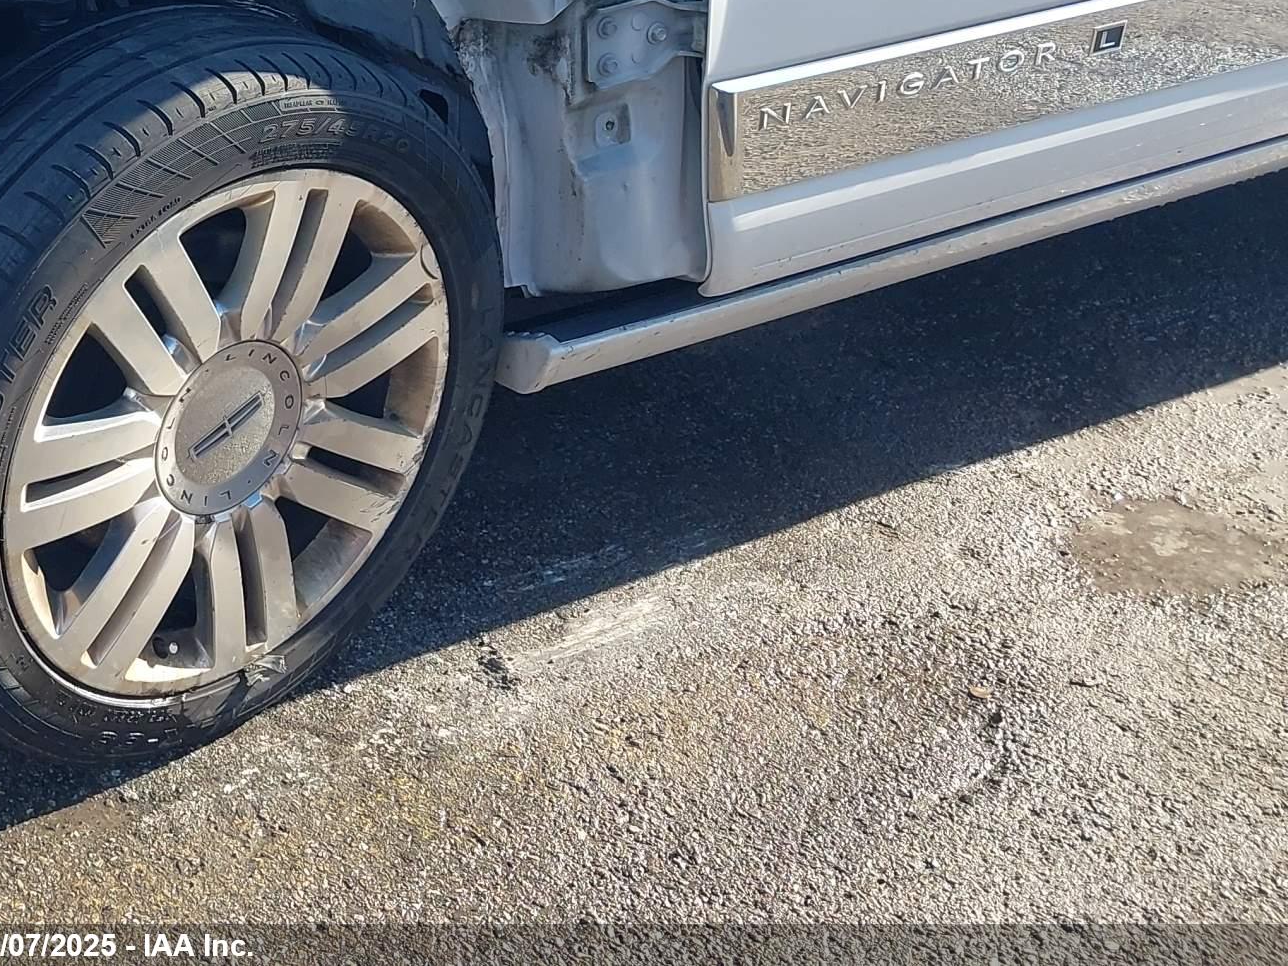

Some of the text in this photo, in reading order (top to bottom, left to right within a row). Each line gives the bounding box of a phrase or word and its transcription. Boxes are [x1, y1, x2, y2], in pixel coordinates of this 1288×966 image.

[758, 40, 1057, 132] NAVIGATOR
[258, 114, 410, 153] 275/45R20
[224, 349, 294, 467] LINCOLN
